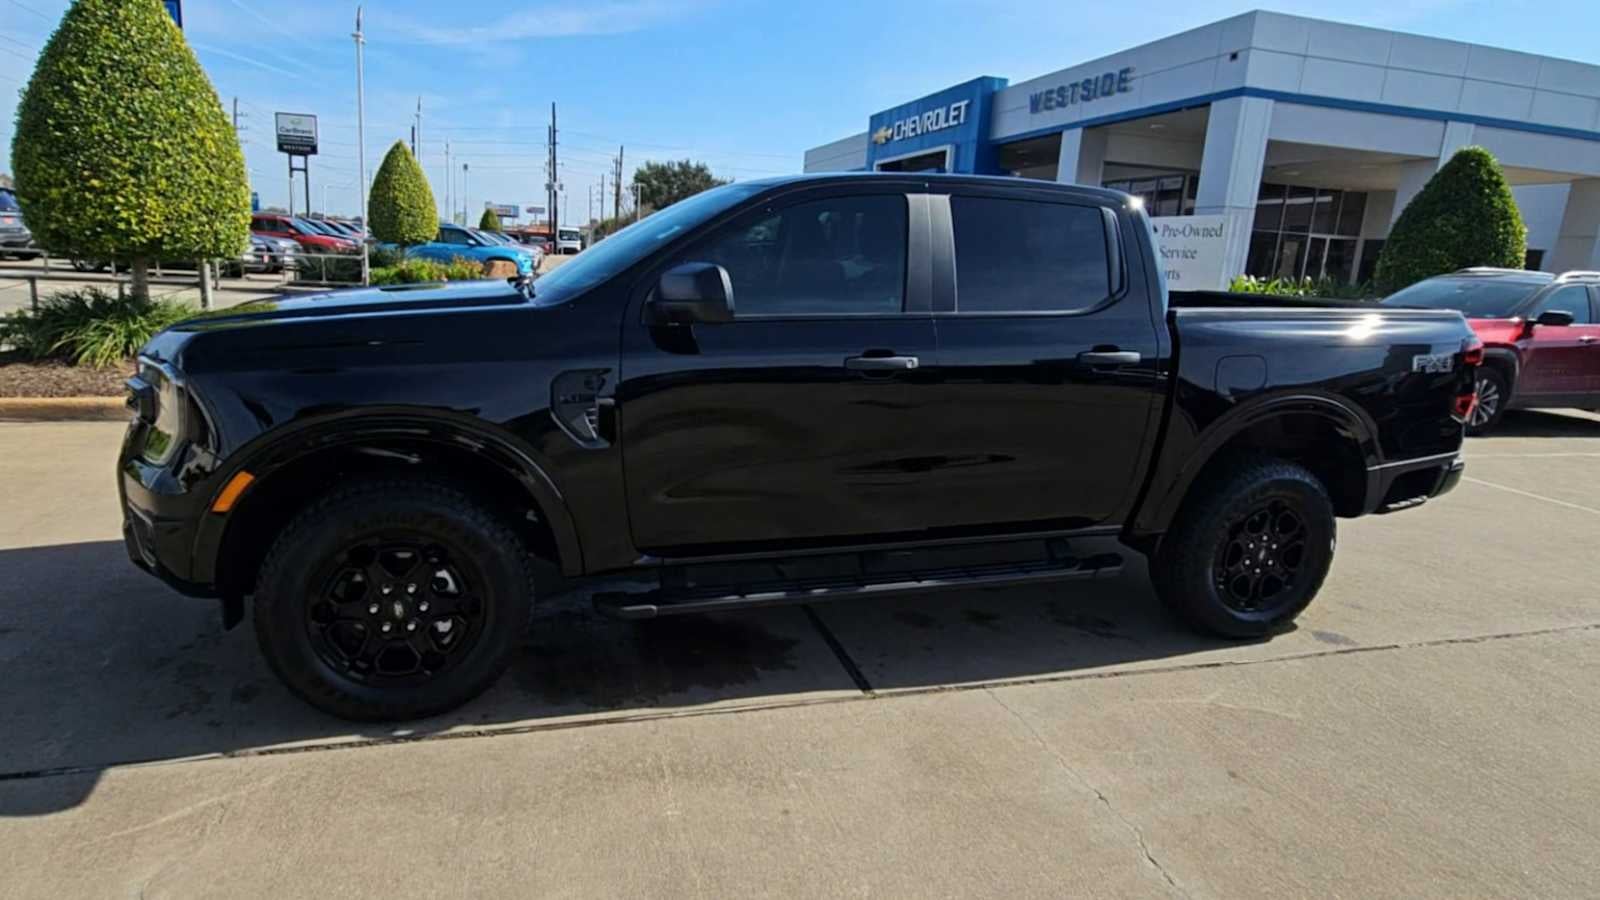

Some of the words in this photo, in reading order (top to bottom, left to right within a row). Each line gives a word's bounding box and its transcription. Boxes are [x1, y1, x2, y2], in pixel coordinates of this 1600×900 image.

[1029, 66, 1135, 114] WESTSIDE
[893, 99, 970, 141] CHEVROLET
[1162, 223, 1223, 238] Pre-Owned
[1159, 245, 1197, 260] Service
